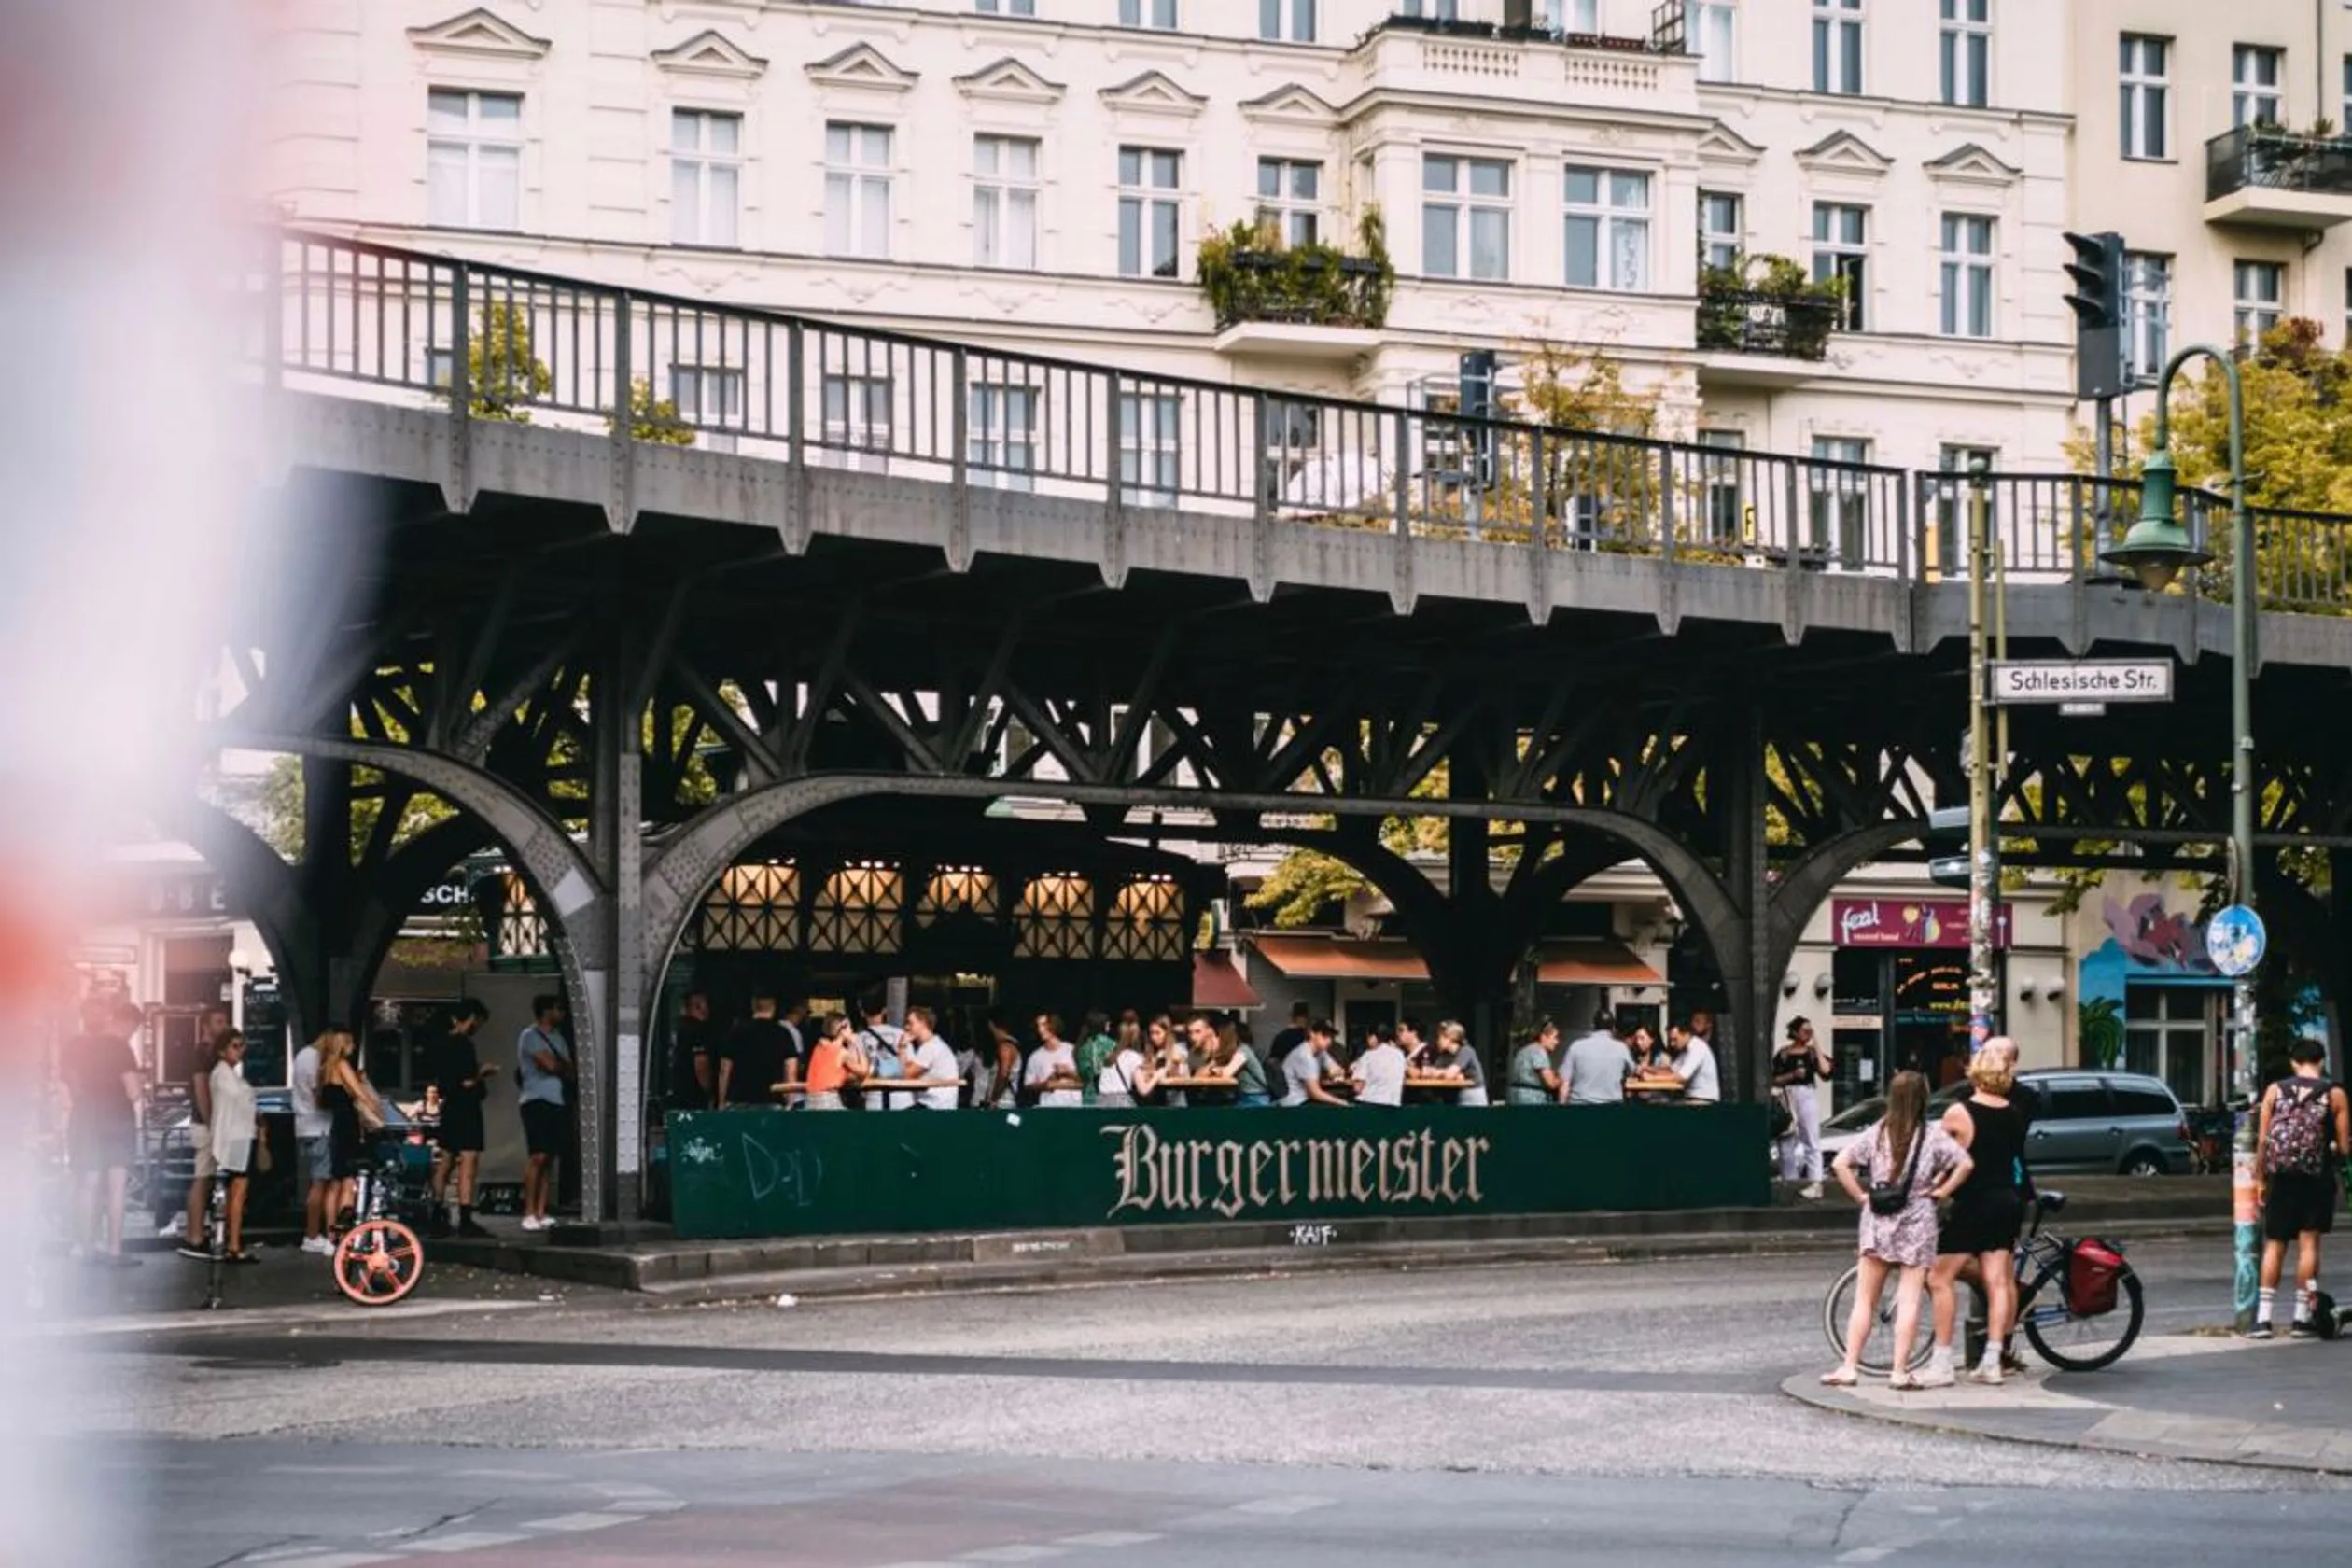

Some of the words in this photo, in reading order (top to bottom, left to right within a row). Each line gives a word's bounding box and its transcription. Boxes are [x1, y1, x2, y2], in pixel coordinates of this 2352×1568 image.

[2009, 670, 2120, 692] Schlesische
[2123, 668, 2159, 690] Str.
[1099, 1123, 1491, 1219] Burgermeister
